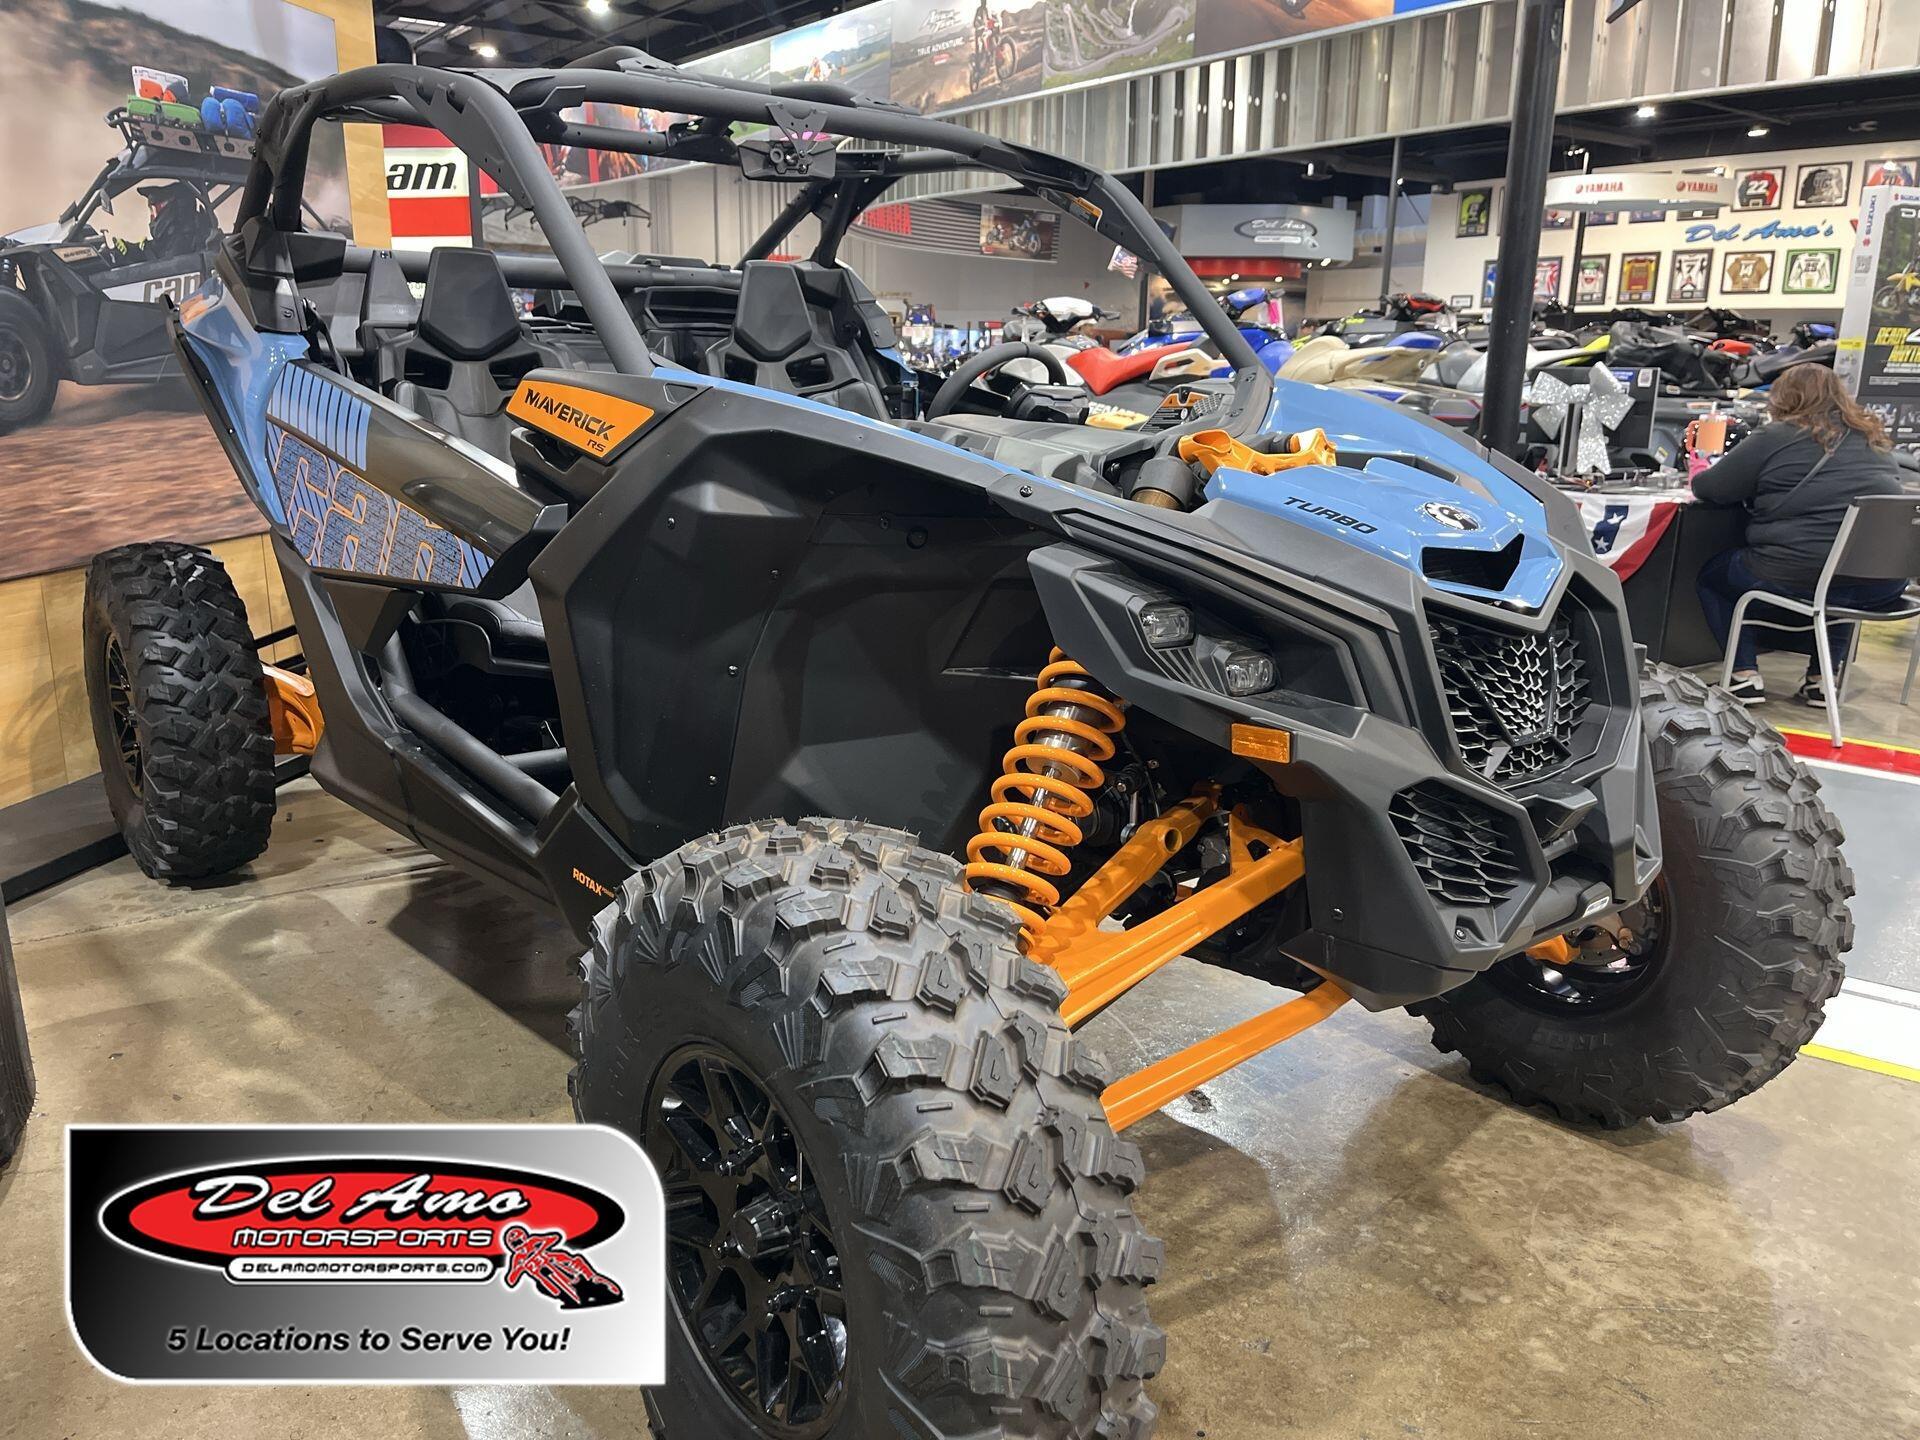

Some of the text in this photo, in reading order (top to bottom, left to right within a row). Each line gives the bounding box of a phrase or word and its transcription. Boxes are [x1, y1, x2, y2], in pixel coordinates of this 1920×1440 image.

[1585, 182, 1623, 192] YAMAHA
[1686, 182, 1718, 193] YAMAHA
[1746, 180, 1768, 195] 22
[1865, 194, 1877, 235] SUZUKI
[1251, 220, 1279, 229] Del
[1685, 220, 1833, 243] Del Amo's
[1686, 264, 1695, 274] 7
[524, 388, 615, 441] MAVERICK
[587, 439, 606, 452] RS
[1283, 496, 1378, 534] TURBO
[572, 867, 602, 896] ROTAX
